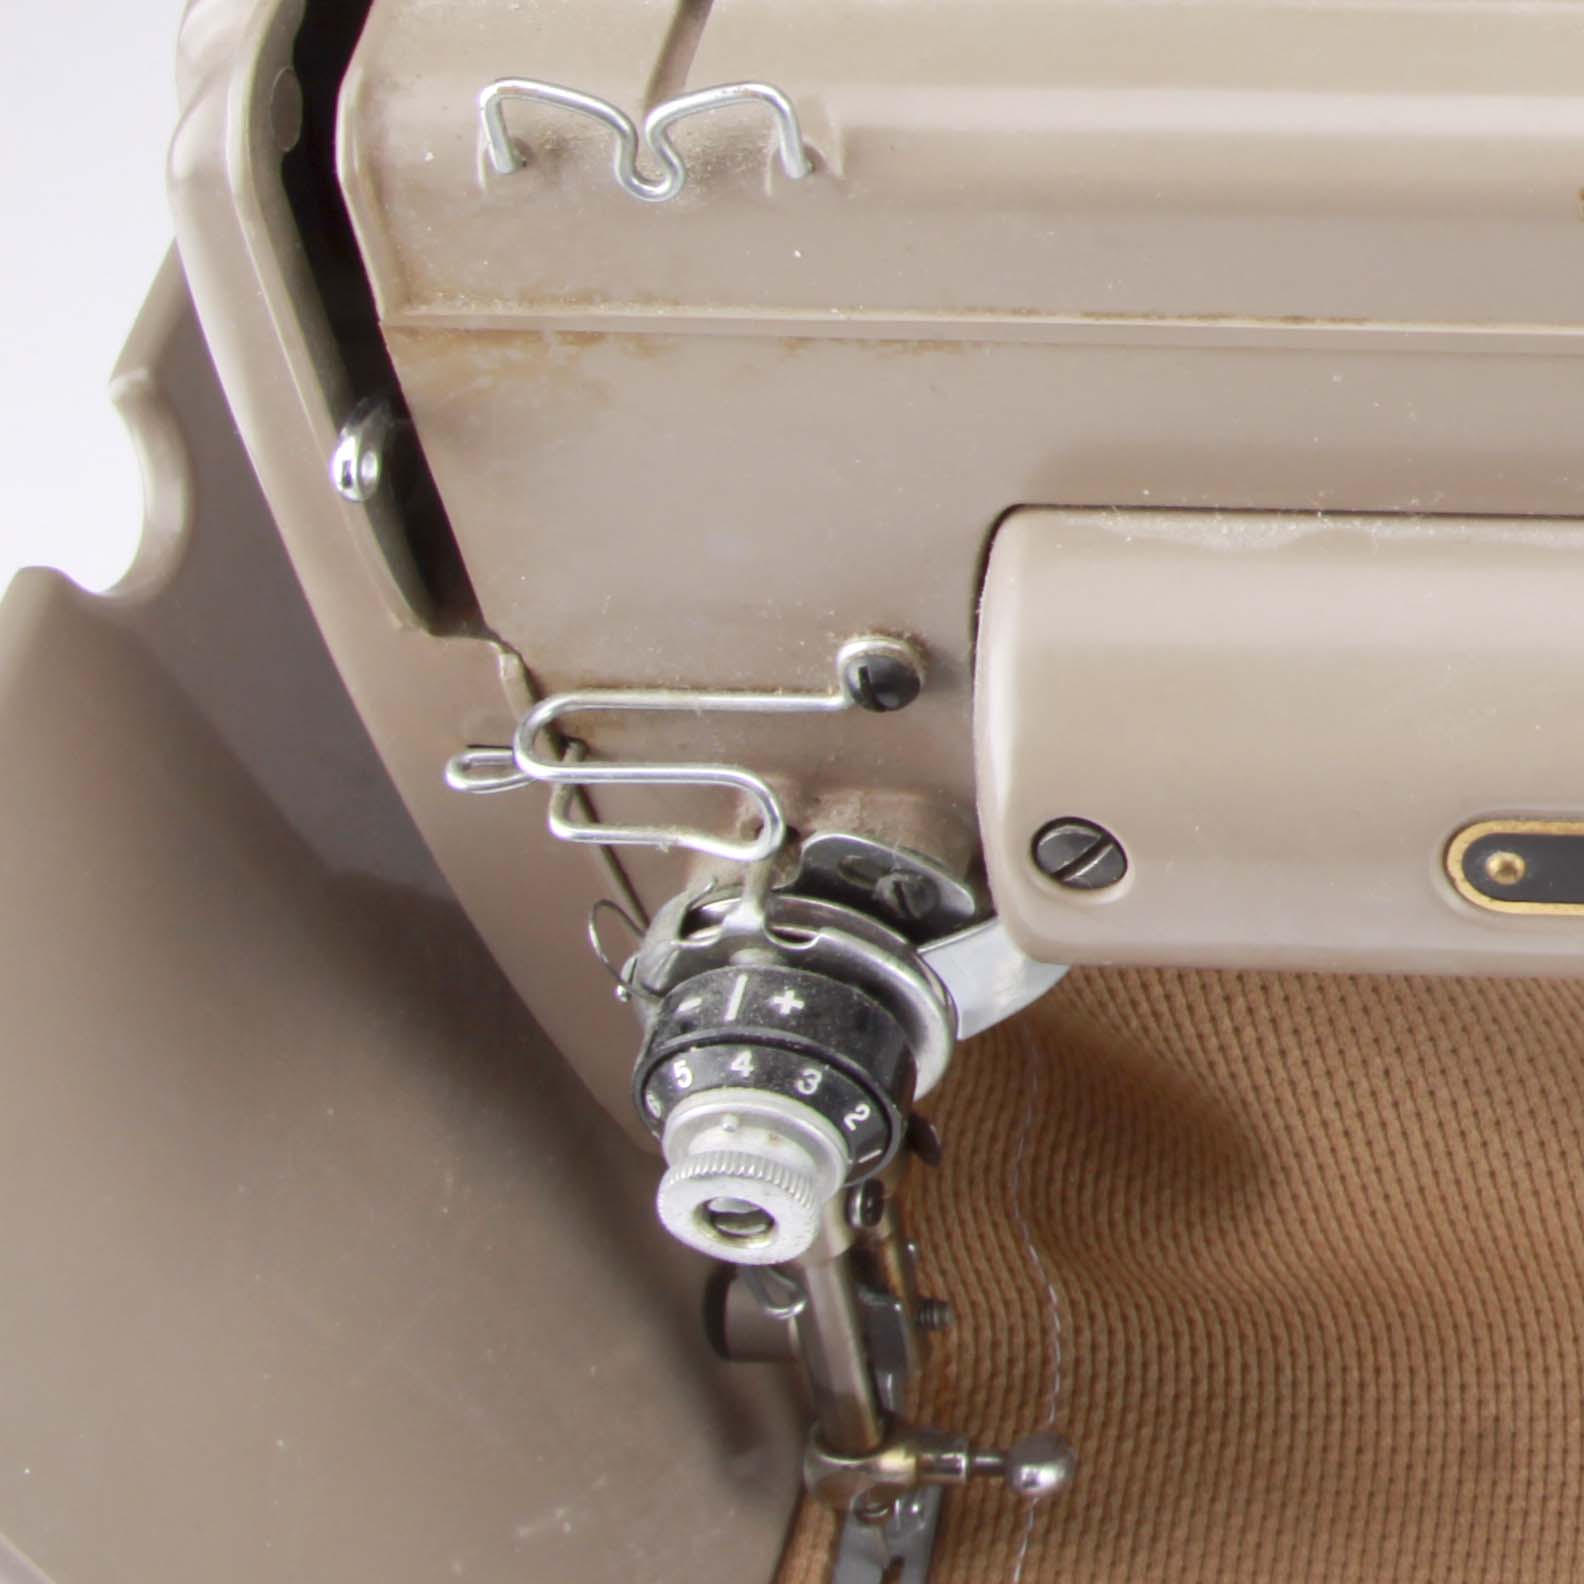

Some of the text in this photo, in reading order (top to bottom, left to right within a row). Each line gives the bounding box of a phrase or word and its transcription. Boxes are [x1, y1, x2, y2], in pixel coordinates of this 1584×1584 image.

[672, 1059, 693, 1088] 5
[730, 1051, 754, 1077] 4
[795, 1068, 822, 1095] 3
[843, 1104, 871, 1130] 2
